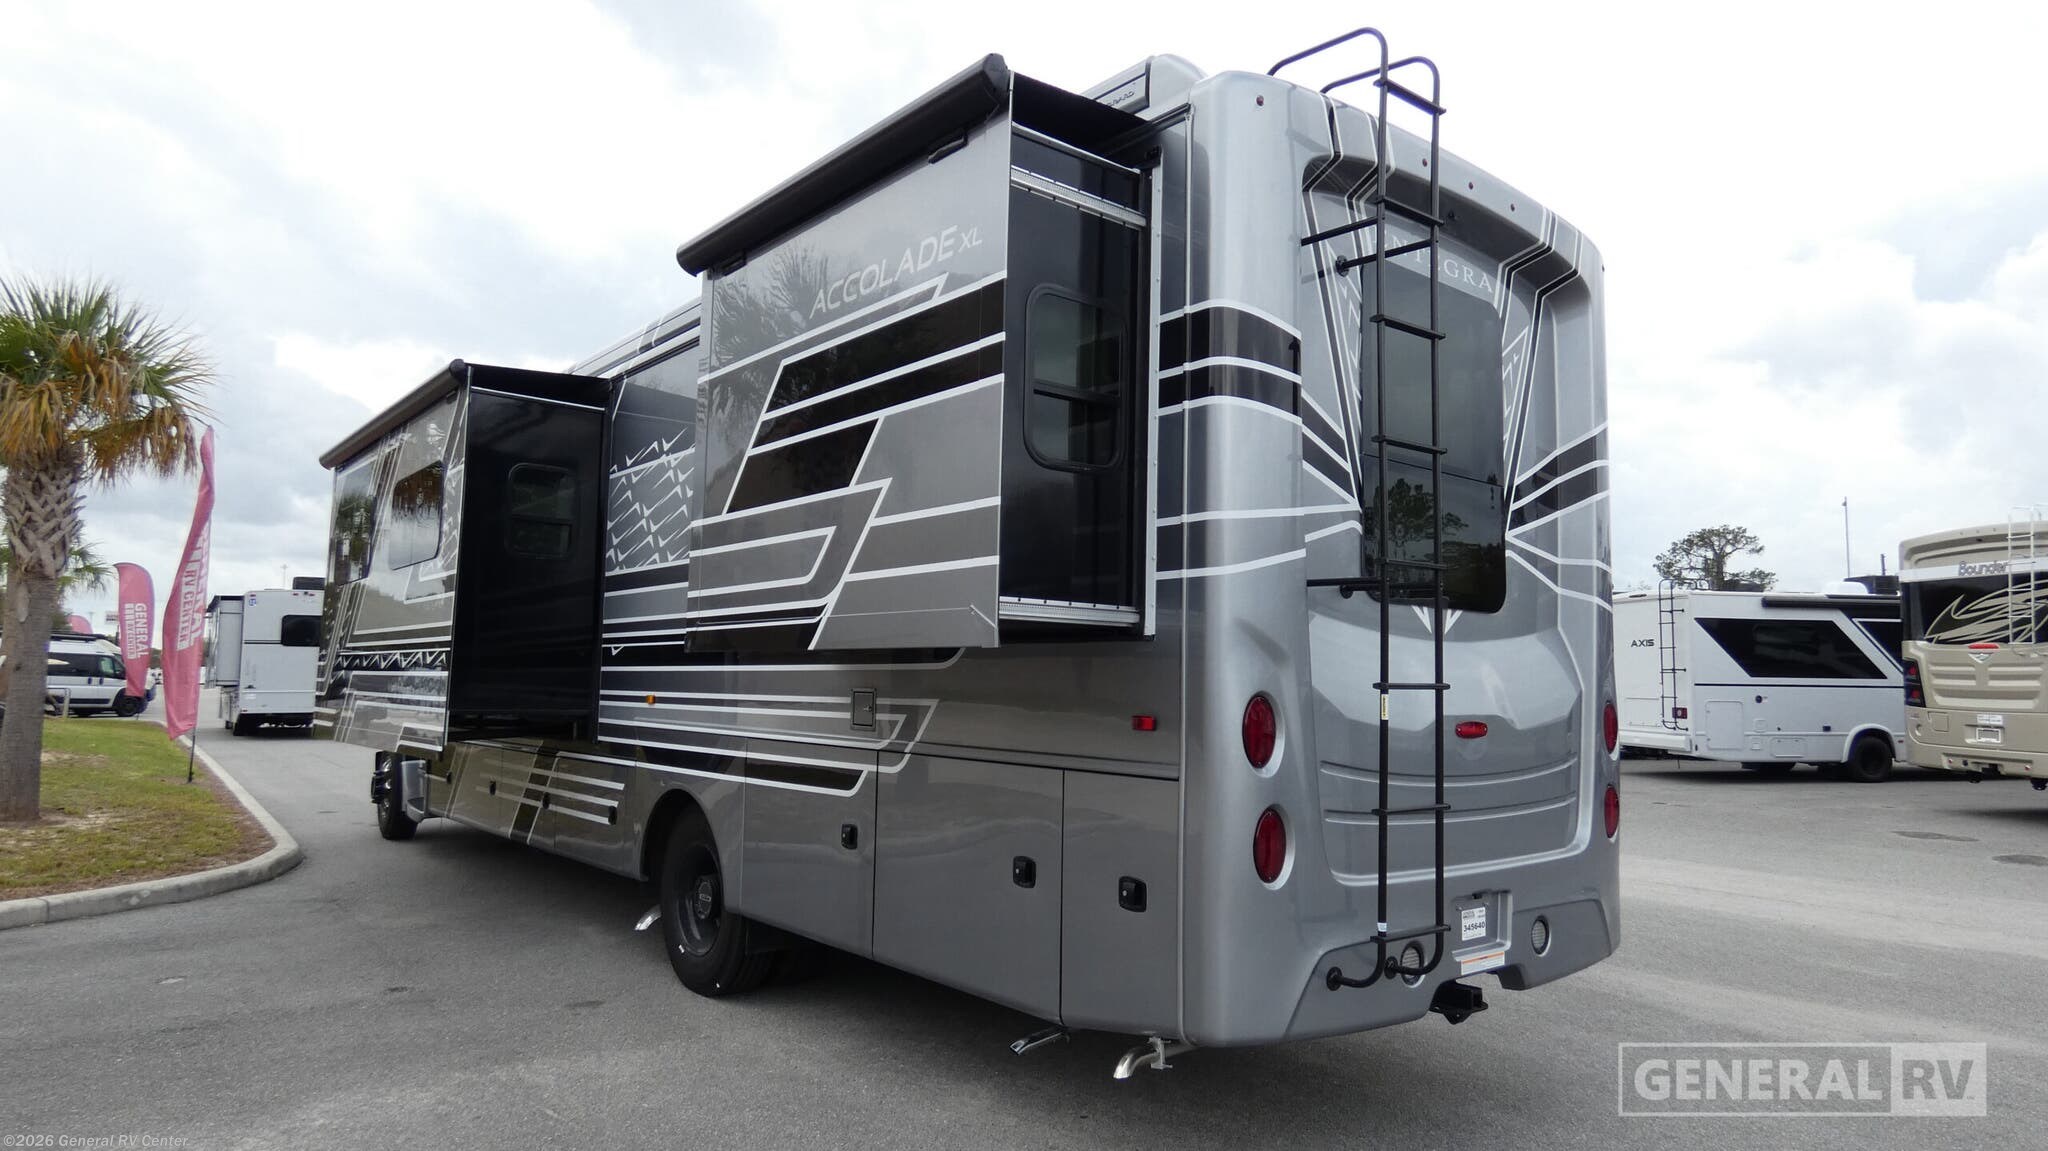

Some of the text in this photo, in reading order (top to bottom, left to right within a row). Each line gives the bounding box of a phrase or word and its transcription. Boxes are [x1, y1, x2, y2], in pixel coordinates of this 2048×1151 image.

[809, 225, 983, 319] ACCOLADE XL
[1959, 561, 2008, 576] Bounder
[135, 603, 149, 658] GENERAL
[180, 591, 195, 643] CENTER
[1631, 639, 1655, 647] AXIS
